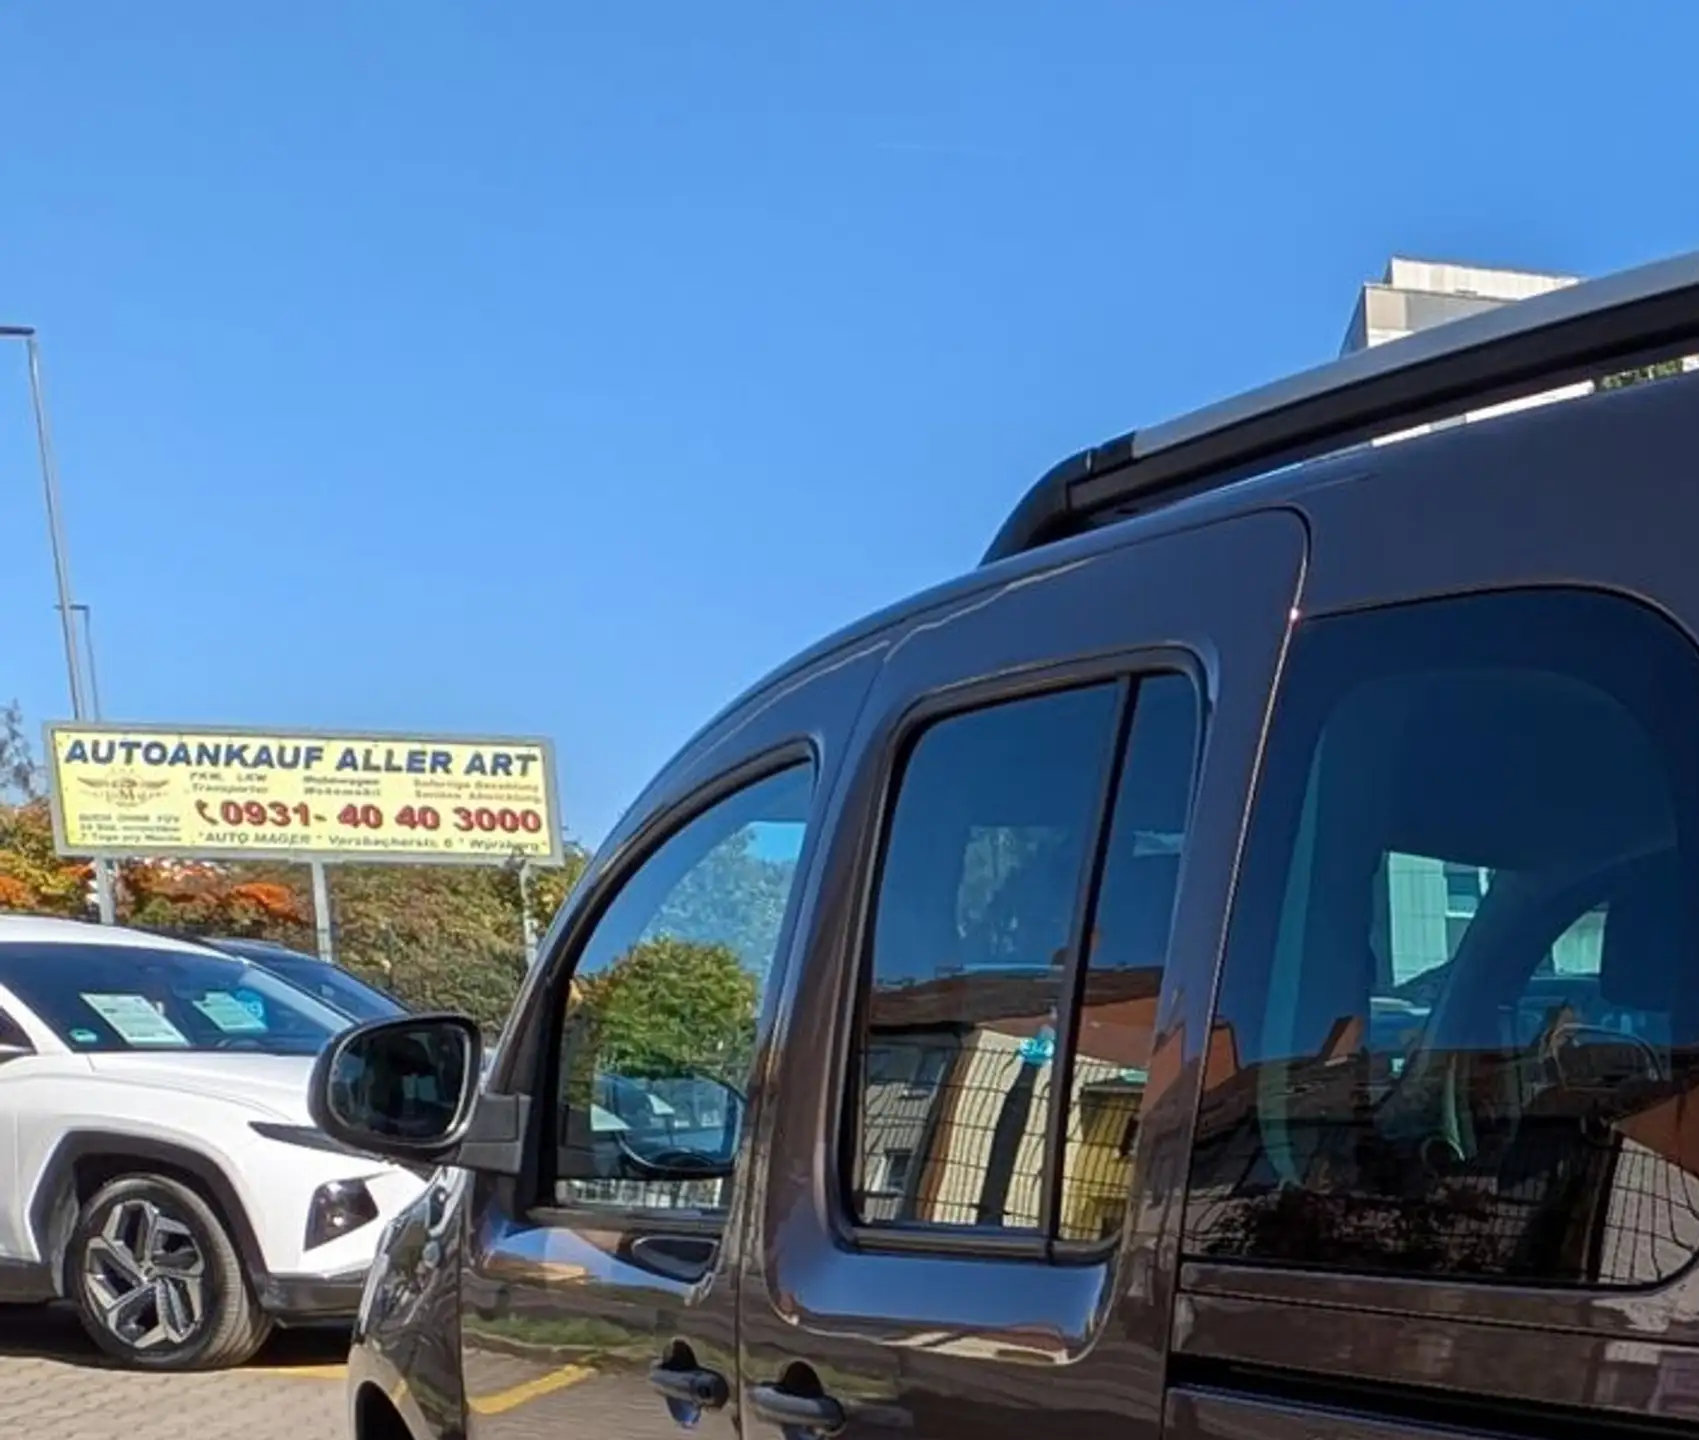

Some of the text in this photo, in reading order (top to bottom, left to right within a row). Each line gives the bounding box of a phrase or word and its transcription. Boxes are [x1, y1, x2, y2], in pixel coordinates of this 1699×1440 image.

[64, 738, 538, 777] AUTOANKAUF ALLER ART
[336, 803, 383, 830] 40
[394, 804, 441, 831] 40
[452, 806, 543, 834] 3000
